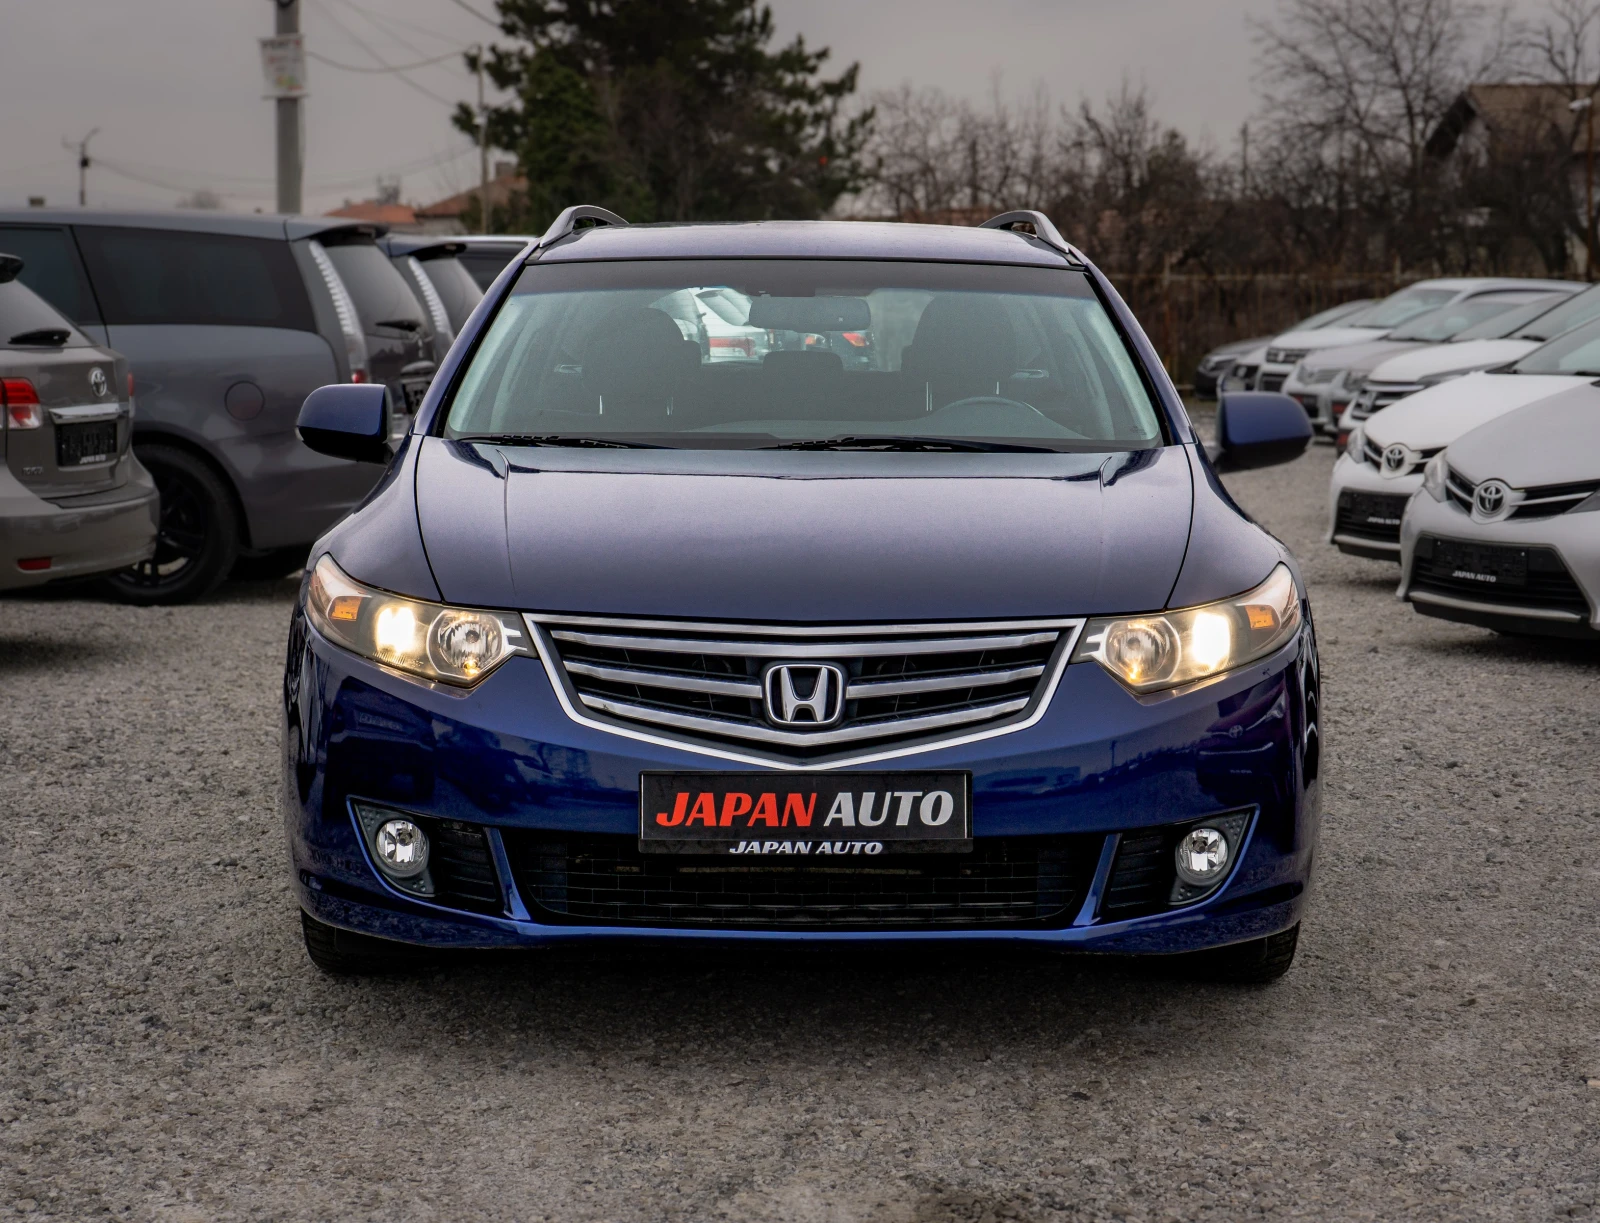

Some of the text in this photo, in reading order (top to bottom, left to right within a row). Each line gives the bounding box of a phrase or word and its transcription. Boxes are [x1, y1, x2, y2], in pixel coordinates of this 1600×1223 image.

[1452, 570, 1497, 583] JAPAN AUTO
[655, 790, 954, 827] JAPAN AUTO
[729, 841, 883, 855] JAPAN AUTO
